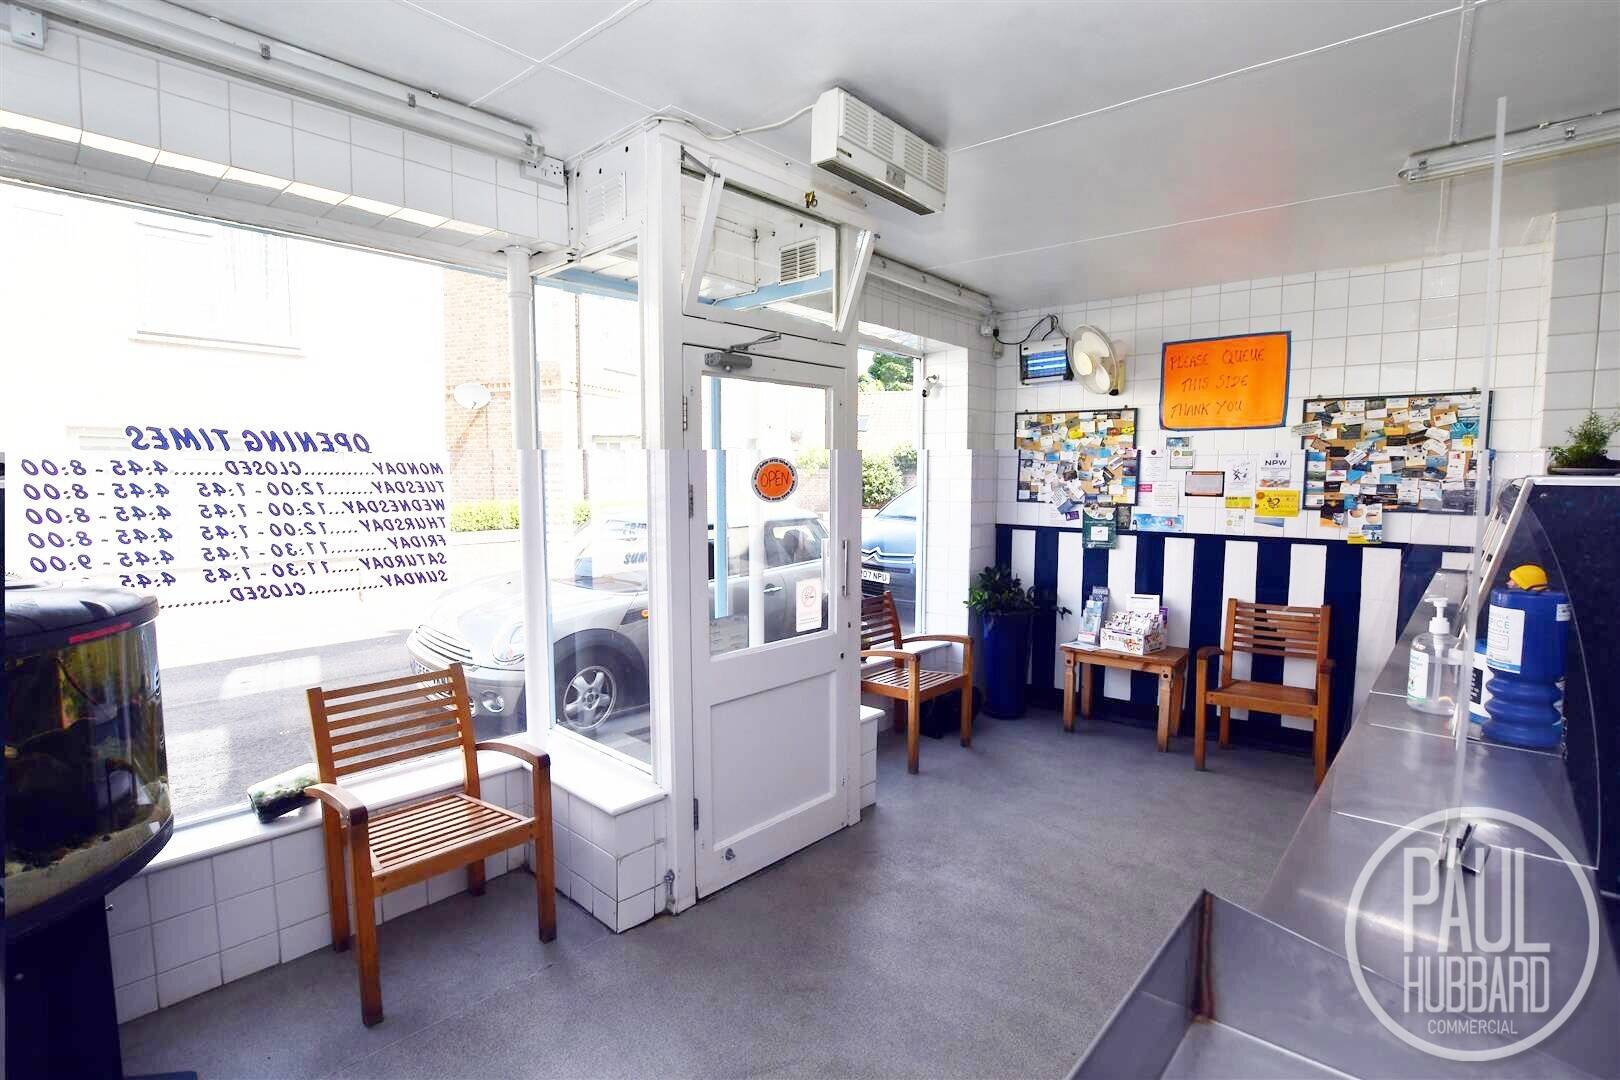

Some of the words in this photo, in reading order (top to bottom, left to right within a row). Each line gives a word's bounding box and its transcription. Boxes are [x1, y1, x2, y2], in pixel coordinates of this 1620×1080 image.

[1169, 352, 1209, 370] PLEASE
[1222, 348, 1265, 365] QUEUE
[1181, 376, 1209, 392] THIS
[1215, 374, 1249, 389] SIDE
[1170, 402, 1209, 419] THANK
[1216, 400, 1243, 414] YOU
[1264, 458, 1287, 467] NPW
[760, 470, 790, 489] OPEN
